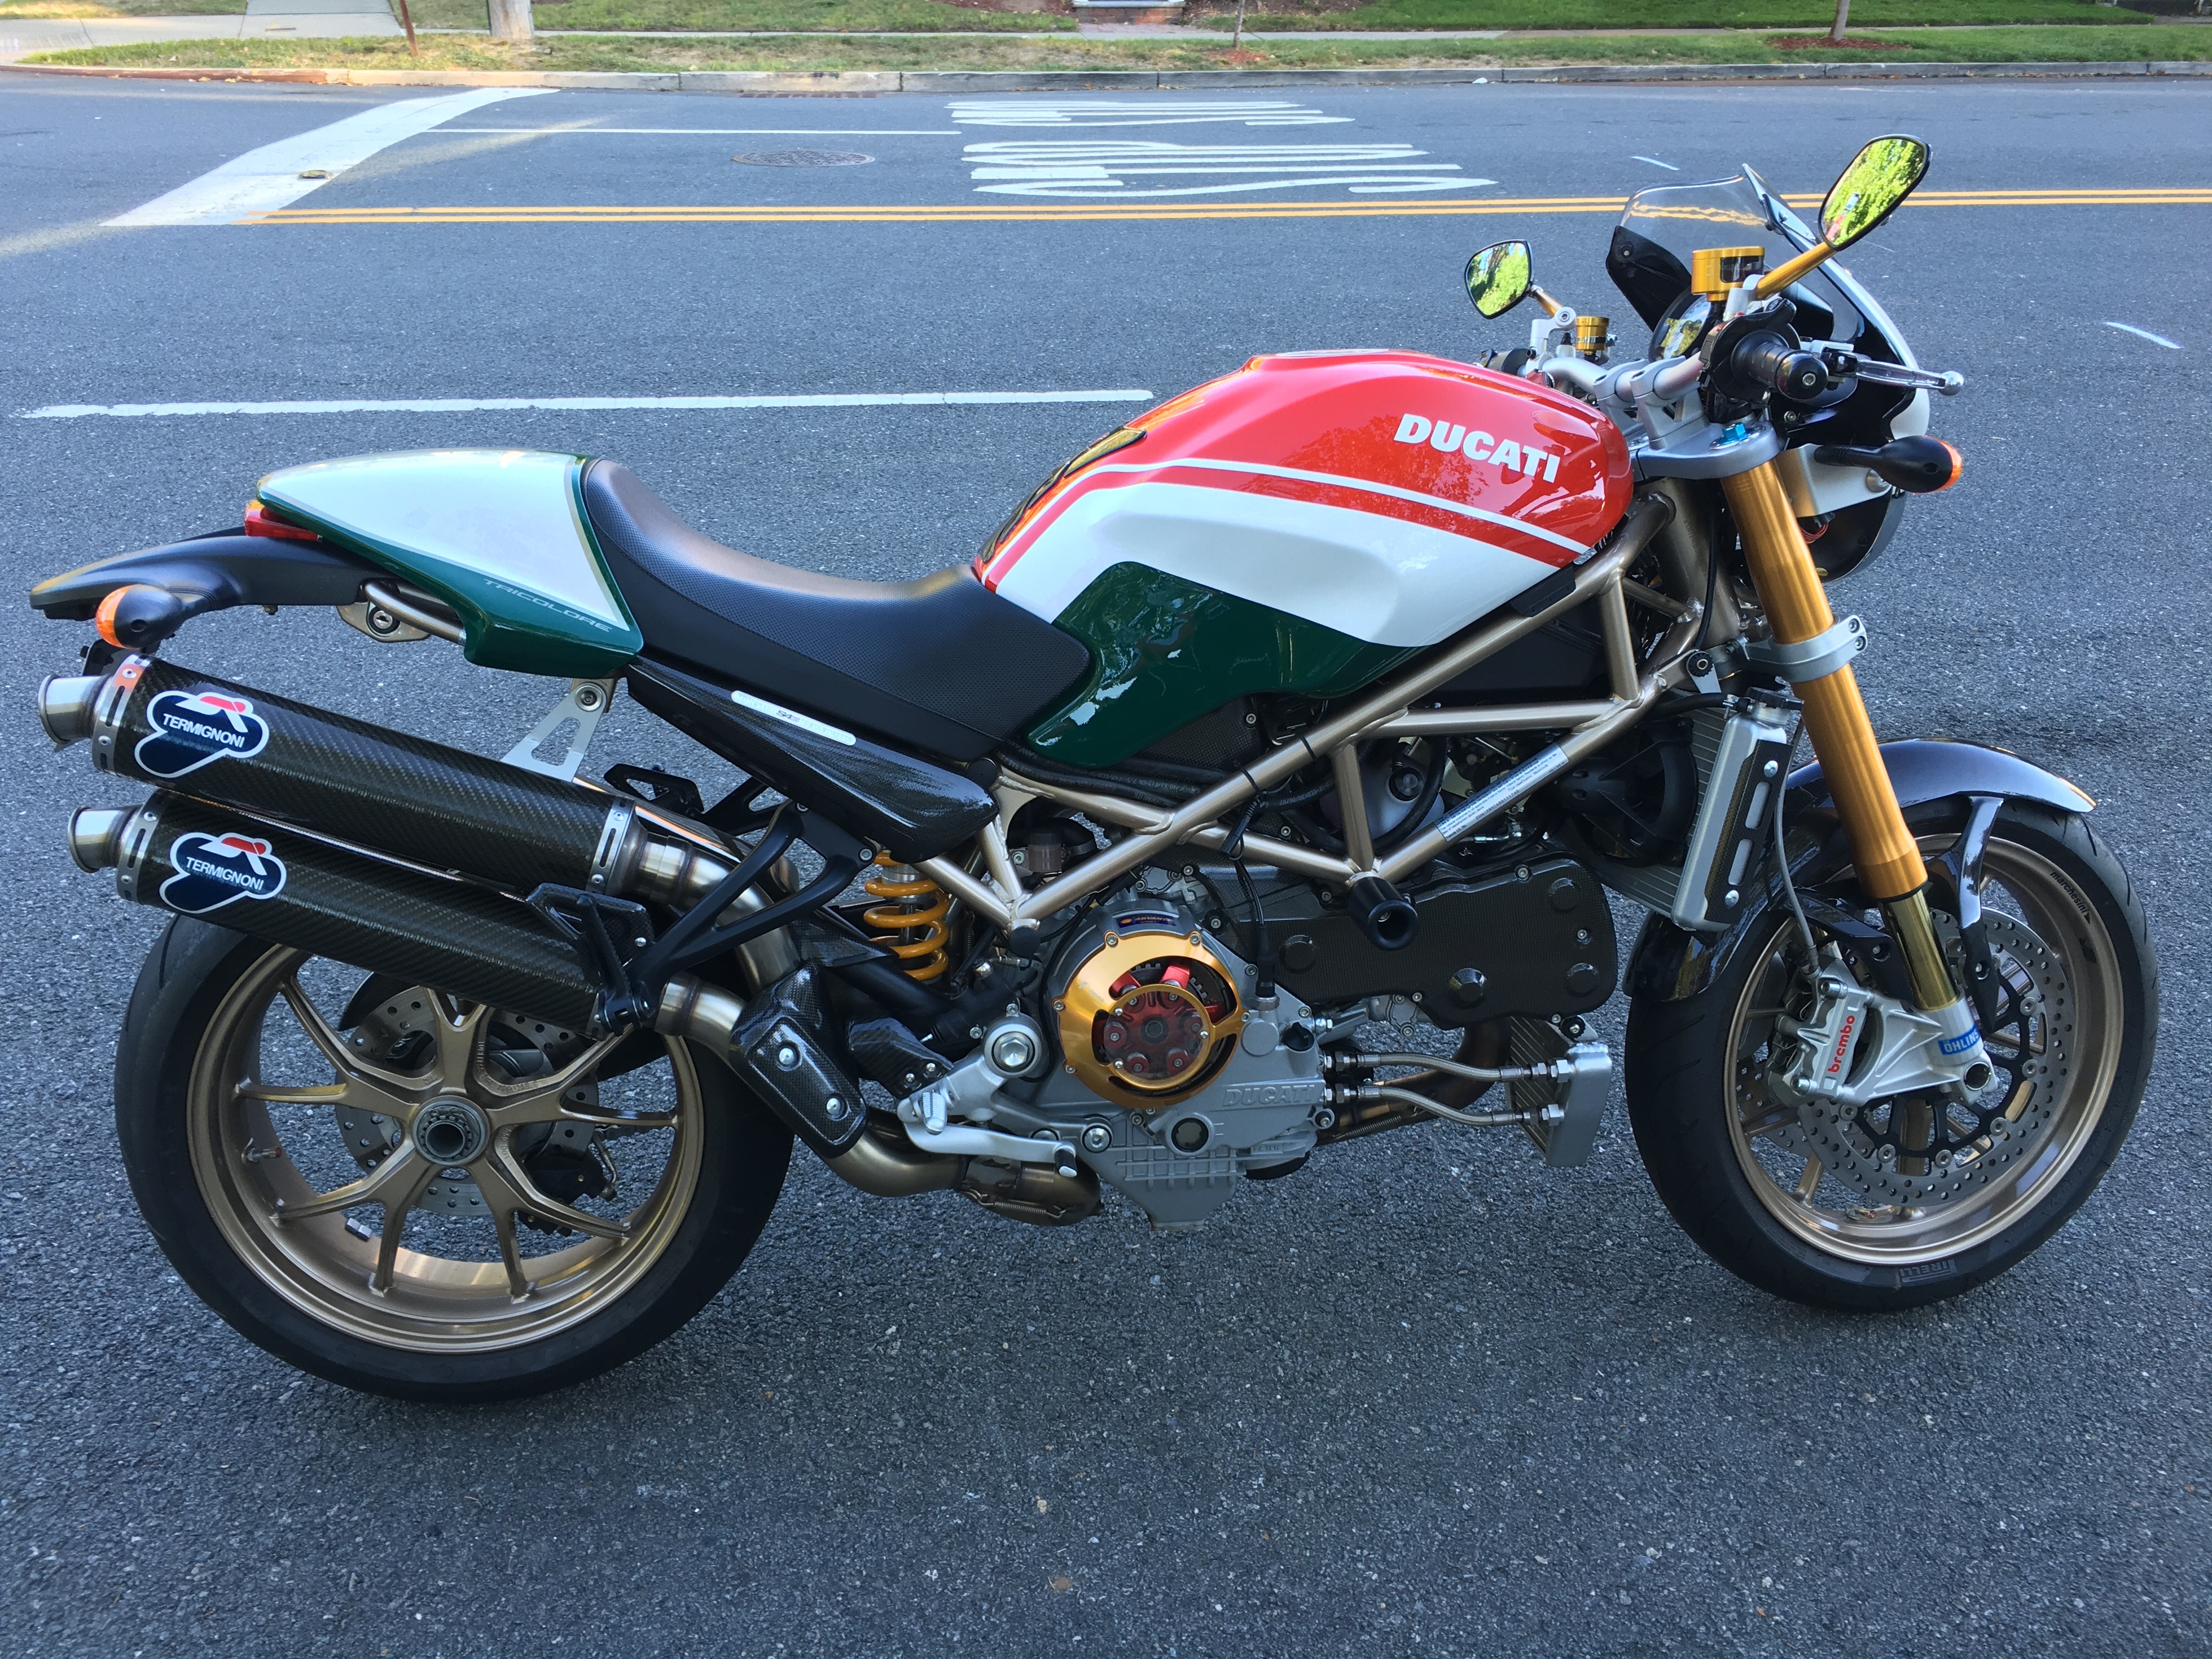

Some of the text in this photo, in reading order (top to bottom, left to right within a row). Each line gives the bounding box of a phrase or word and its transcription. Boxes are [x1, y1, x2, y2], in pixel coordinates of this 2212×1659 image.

[961, 141, 1499, 197] STOP
[1393, 413, 1560, 483] DUCATI
[483, 578, 612, 632] TRICOLORE
[163, 713, 245, 748] TERMIGNONI
[186, 856, 263, 891] TERMIGNONI
[2050, 872, 2089, 913] marchesini
[1827, 1015, 1856, 1073] brembo
[1222, 1085, 1315, 1107] DUCATI
[1899, 1259, 1957, 1283] PIRELLI
